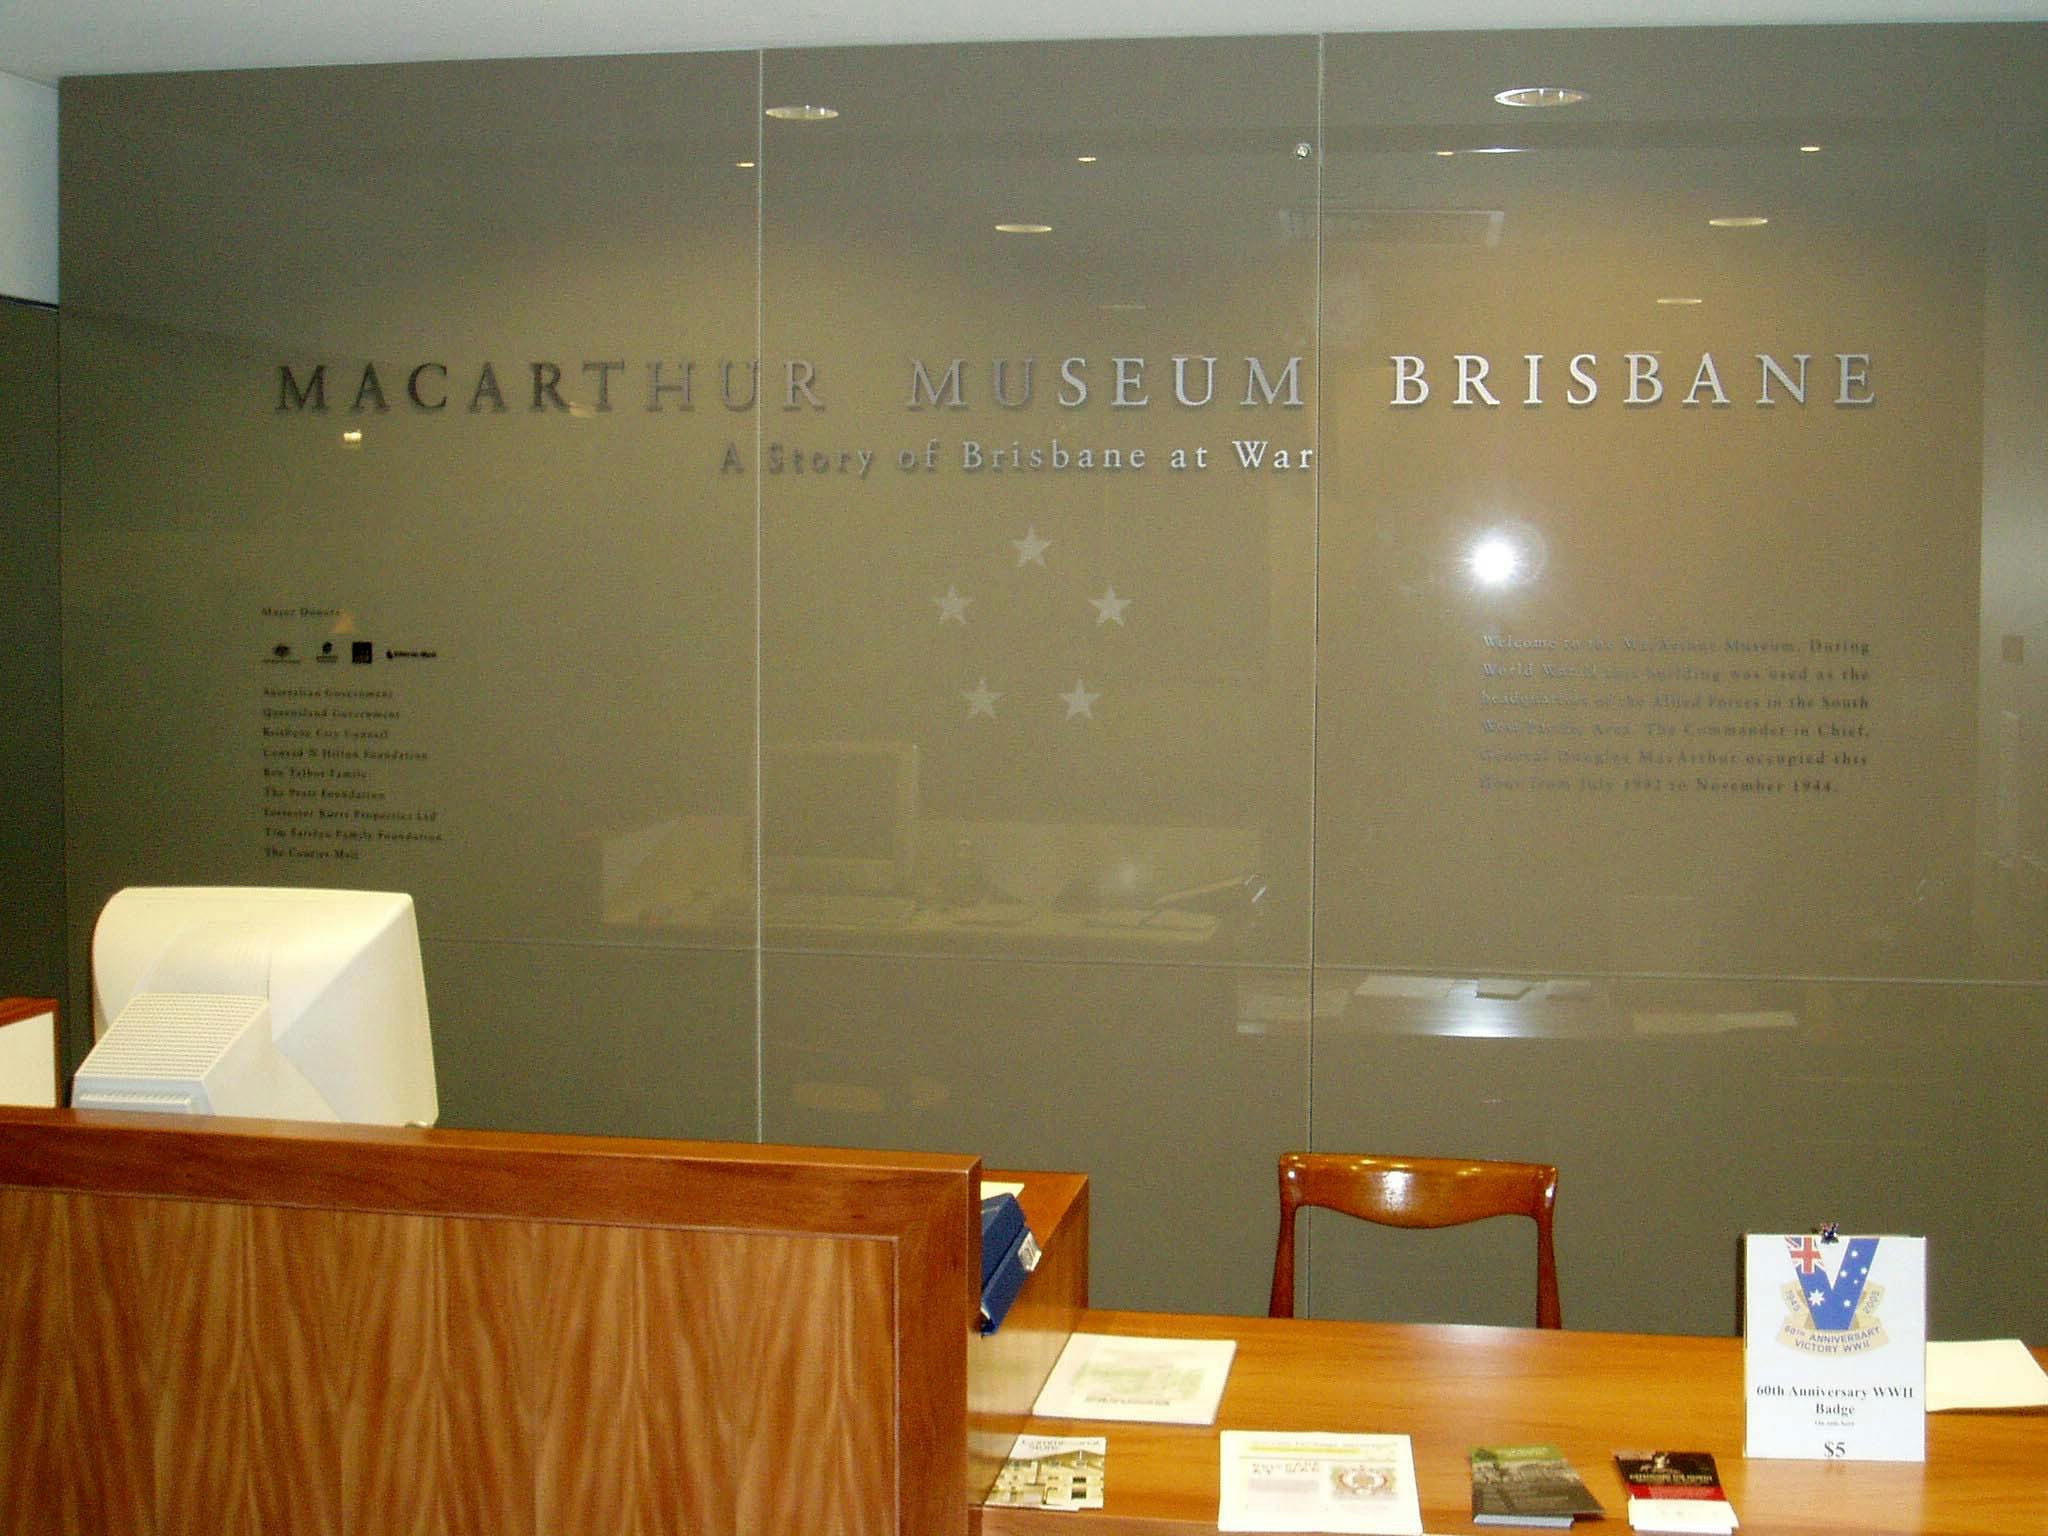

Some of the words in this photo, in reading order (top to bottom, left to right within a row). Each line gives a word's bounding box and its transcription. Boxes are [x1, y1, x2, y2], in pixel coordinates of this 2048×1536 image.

[275, 359, 826, 415] MACARTHUR
[905, 355, 1305, 411] MUSEUM
[1389, 352, 1876, 407] BRISBANE
[720, 440, 744, 474] A
[767, 444, 873, 479] Story
[900, 438, 939, 470] of
[961, 439, 1147, 471] Brisbane
[1170, 444, 1208, 470] at
[1231, 439, 1315, 470] War
[1808, 1326, 1881, 1344] ANNIVERSARY
[1795, 1340, 1839, 1353] VICTORY
[1843, 1340, 1872, 1352] WWII
[1756, 1384, 1785, 1397] 60th
[1791, 1385, 1867, 1400] Anniversary
[1815, 1403, 1856, 1417] Badge
[1824, 1441, 1847, 1458] $5
